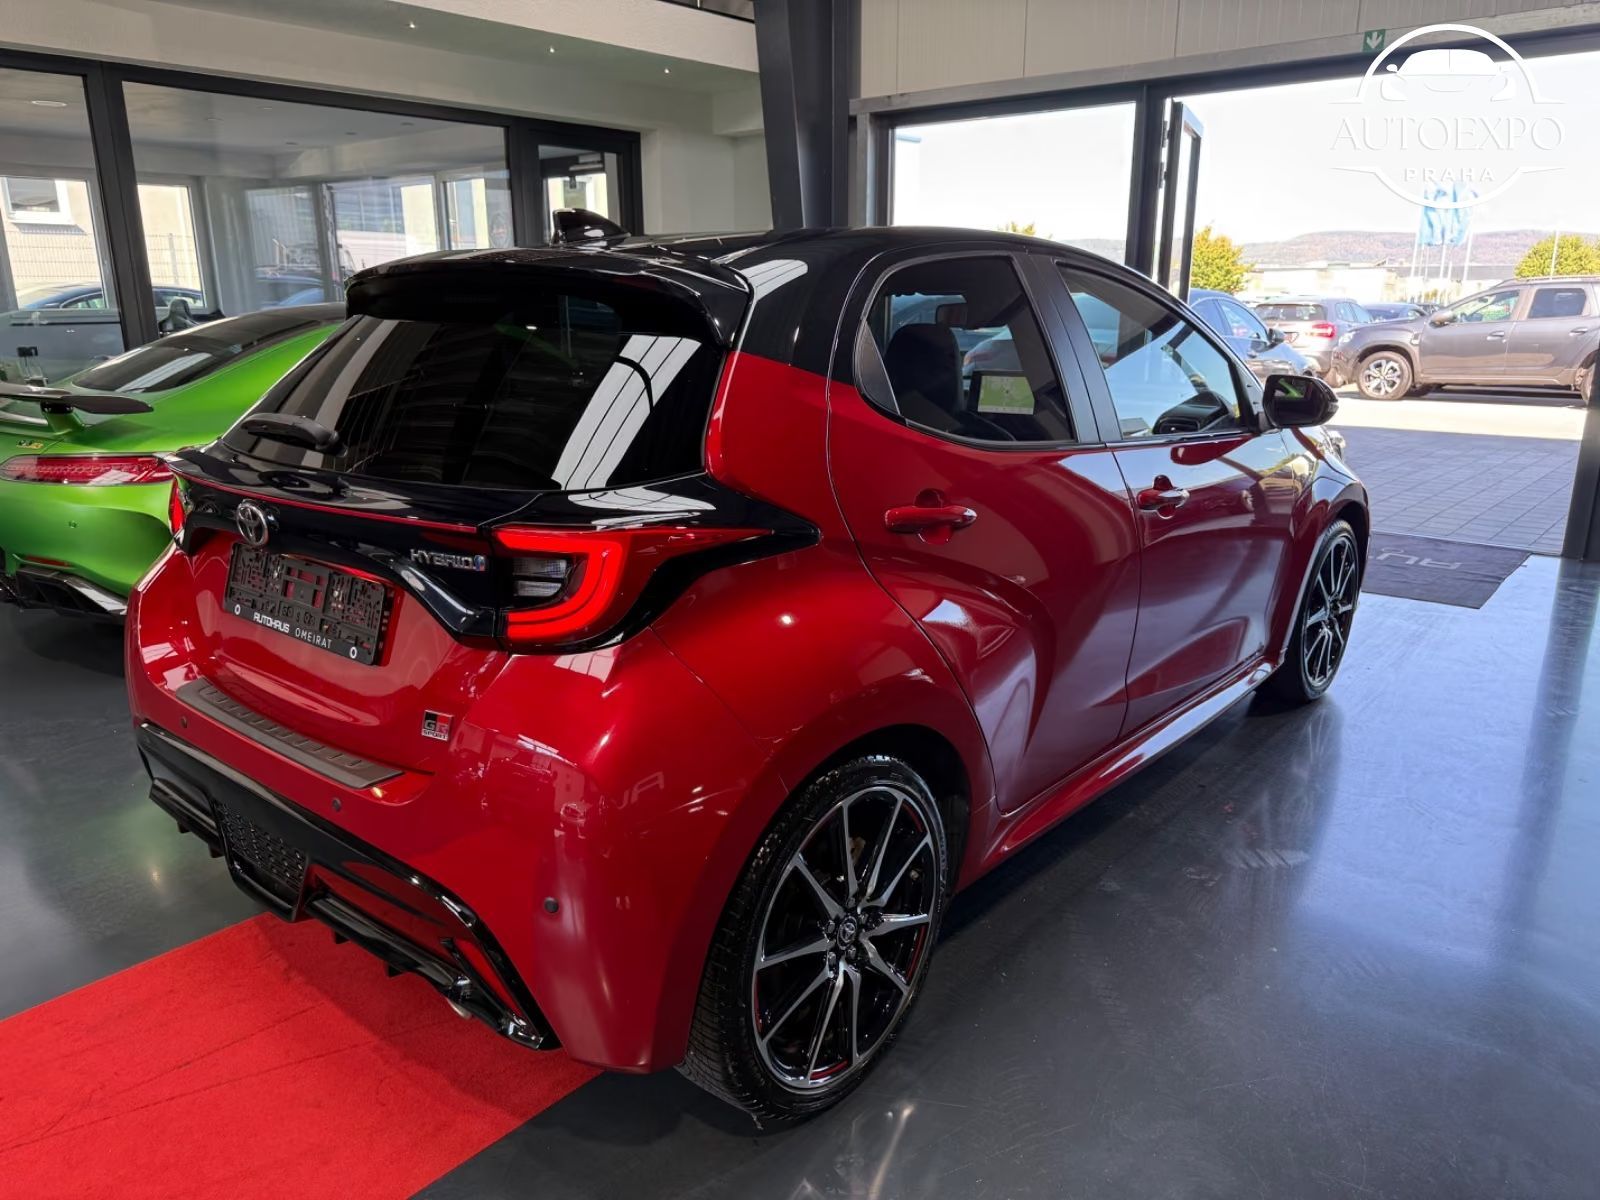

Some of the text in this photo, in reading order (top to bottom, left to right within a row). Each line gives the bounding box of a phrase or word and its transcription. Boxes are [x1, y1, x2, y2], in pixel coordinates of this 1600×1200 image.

[410, 549, 473, 569] HYBRID
[252, 611, 290, 634] AUTOHAUS
[295, 627, 332, 649] OMEIRAT
[422, 730, 449, 741] SPORT
